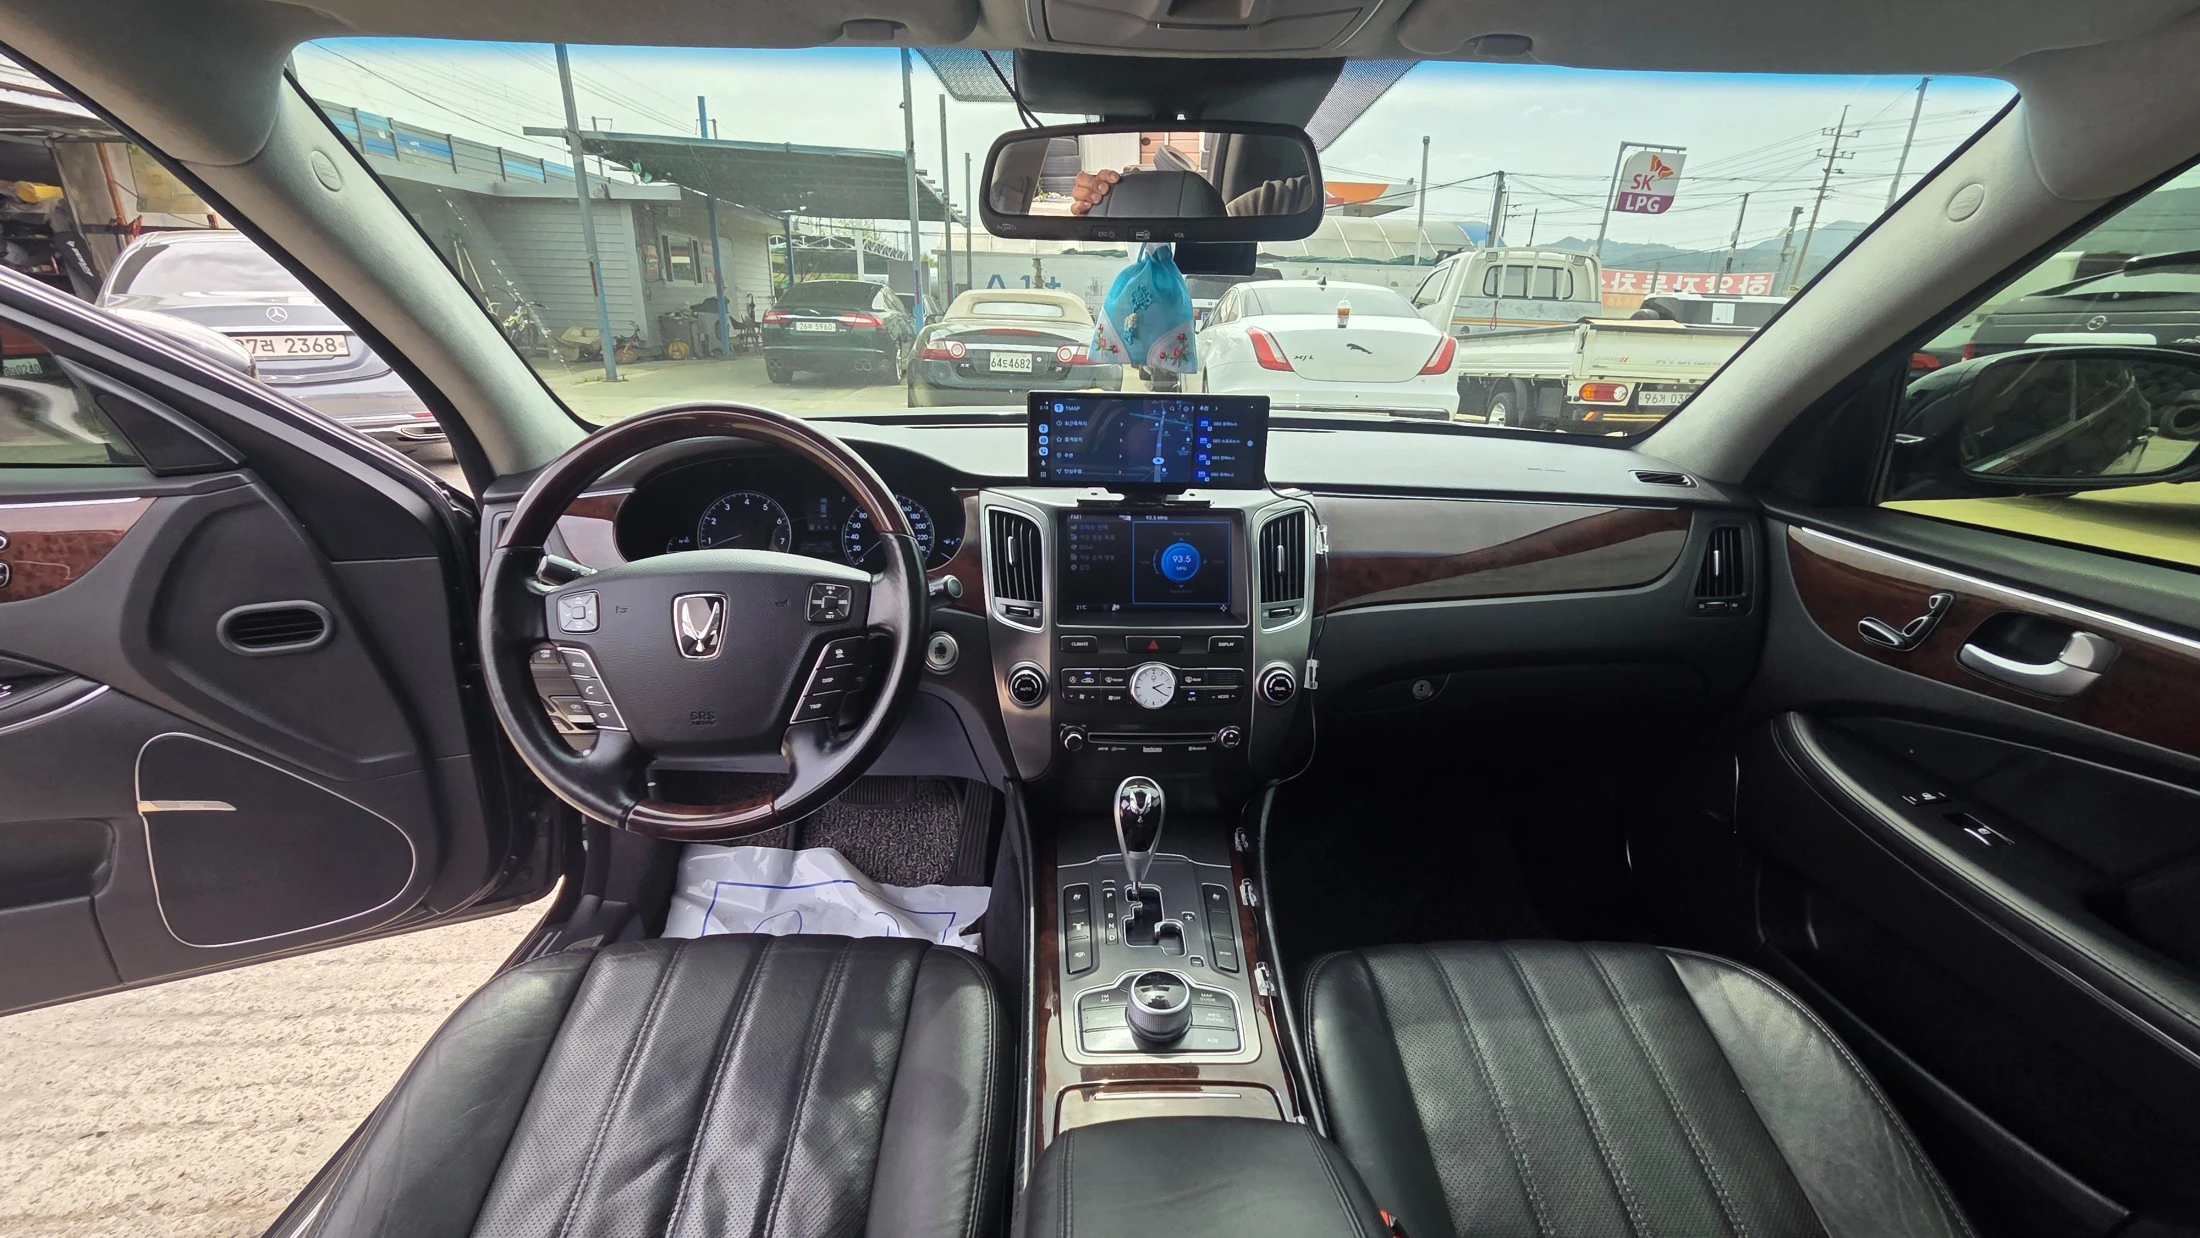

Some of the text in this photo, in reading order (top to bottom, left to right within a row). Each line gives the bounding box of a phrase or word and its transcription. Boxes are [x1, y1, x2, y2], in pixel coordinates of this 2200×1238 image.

[1630, 173, 1655, 191] SK
[1625, 194, 1661, 213] LPG
[285, 337, 337, 354] 2368
[724, 503, 731, 511] 3
[763, 503, 768, 511] 5
[711, 517, 717, 525] 2
[776, 517, 782, 525] 6
[780, 537, 786, 545] 7
[852, 544, 862, 552] 20
[1172, 554, 1192, 563] 93.5
[690, 710, 716, 720] SRS
